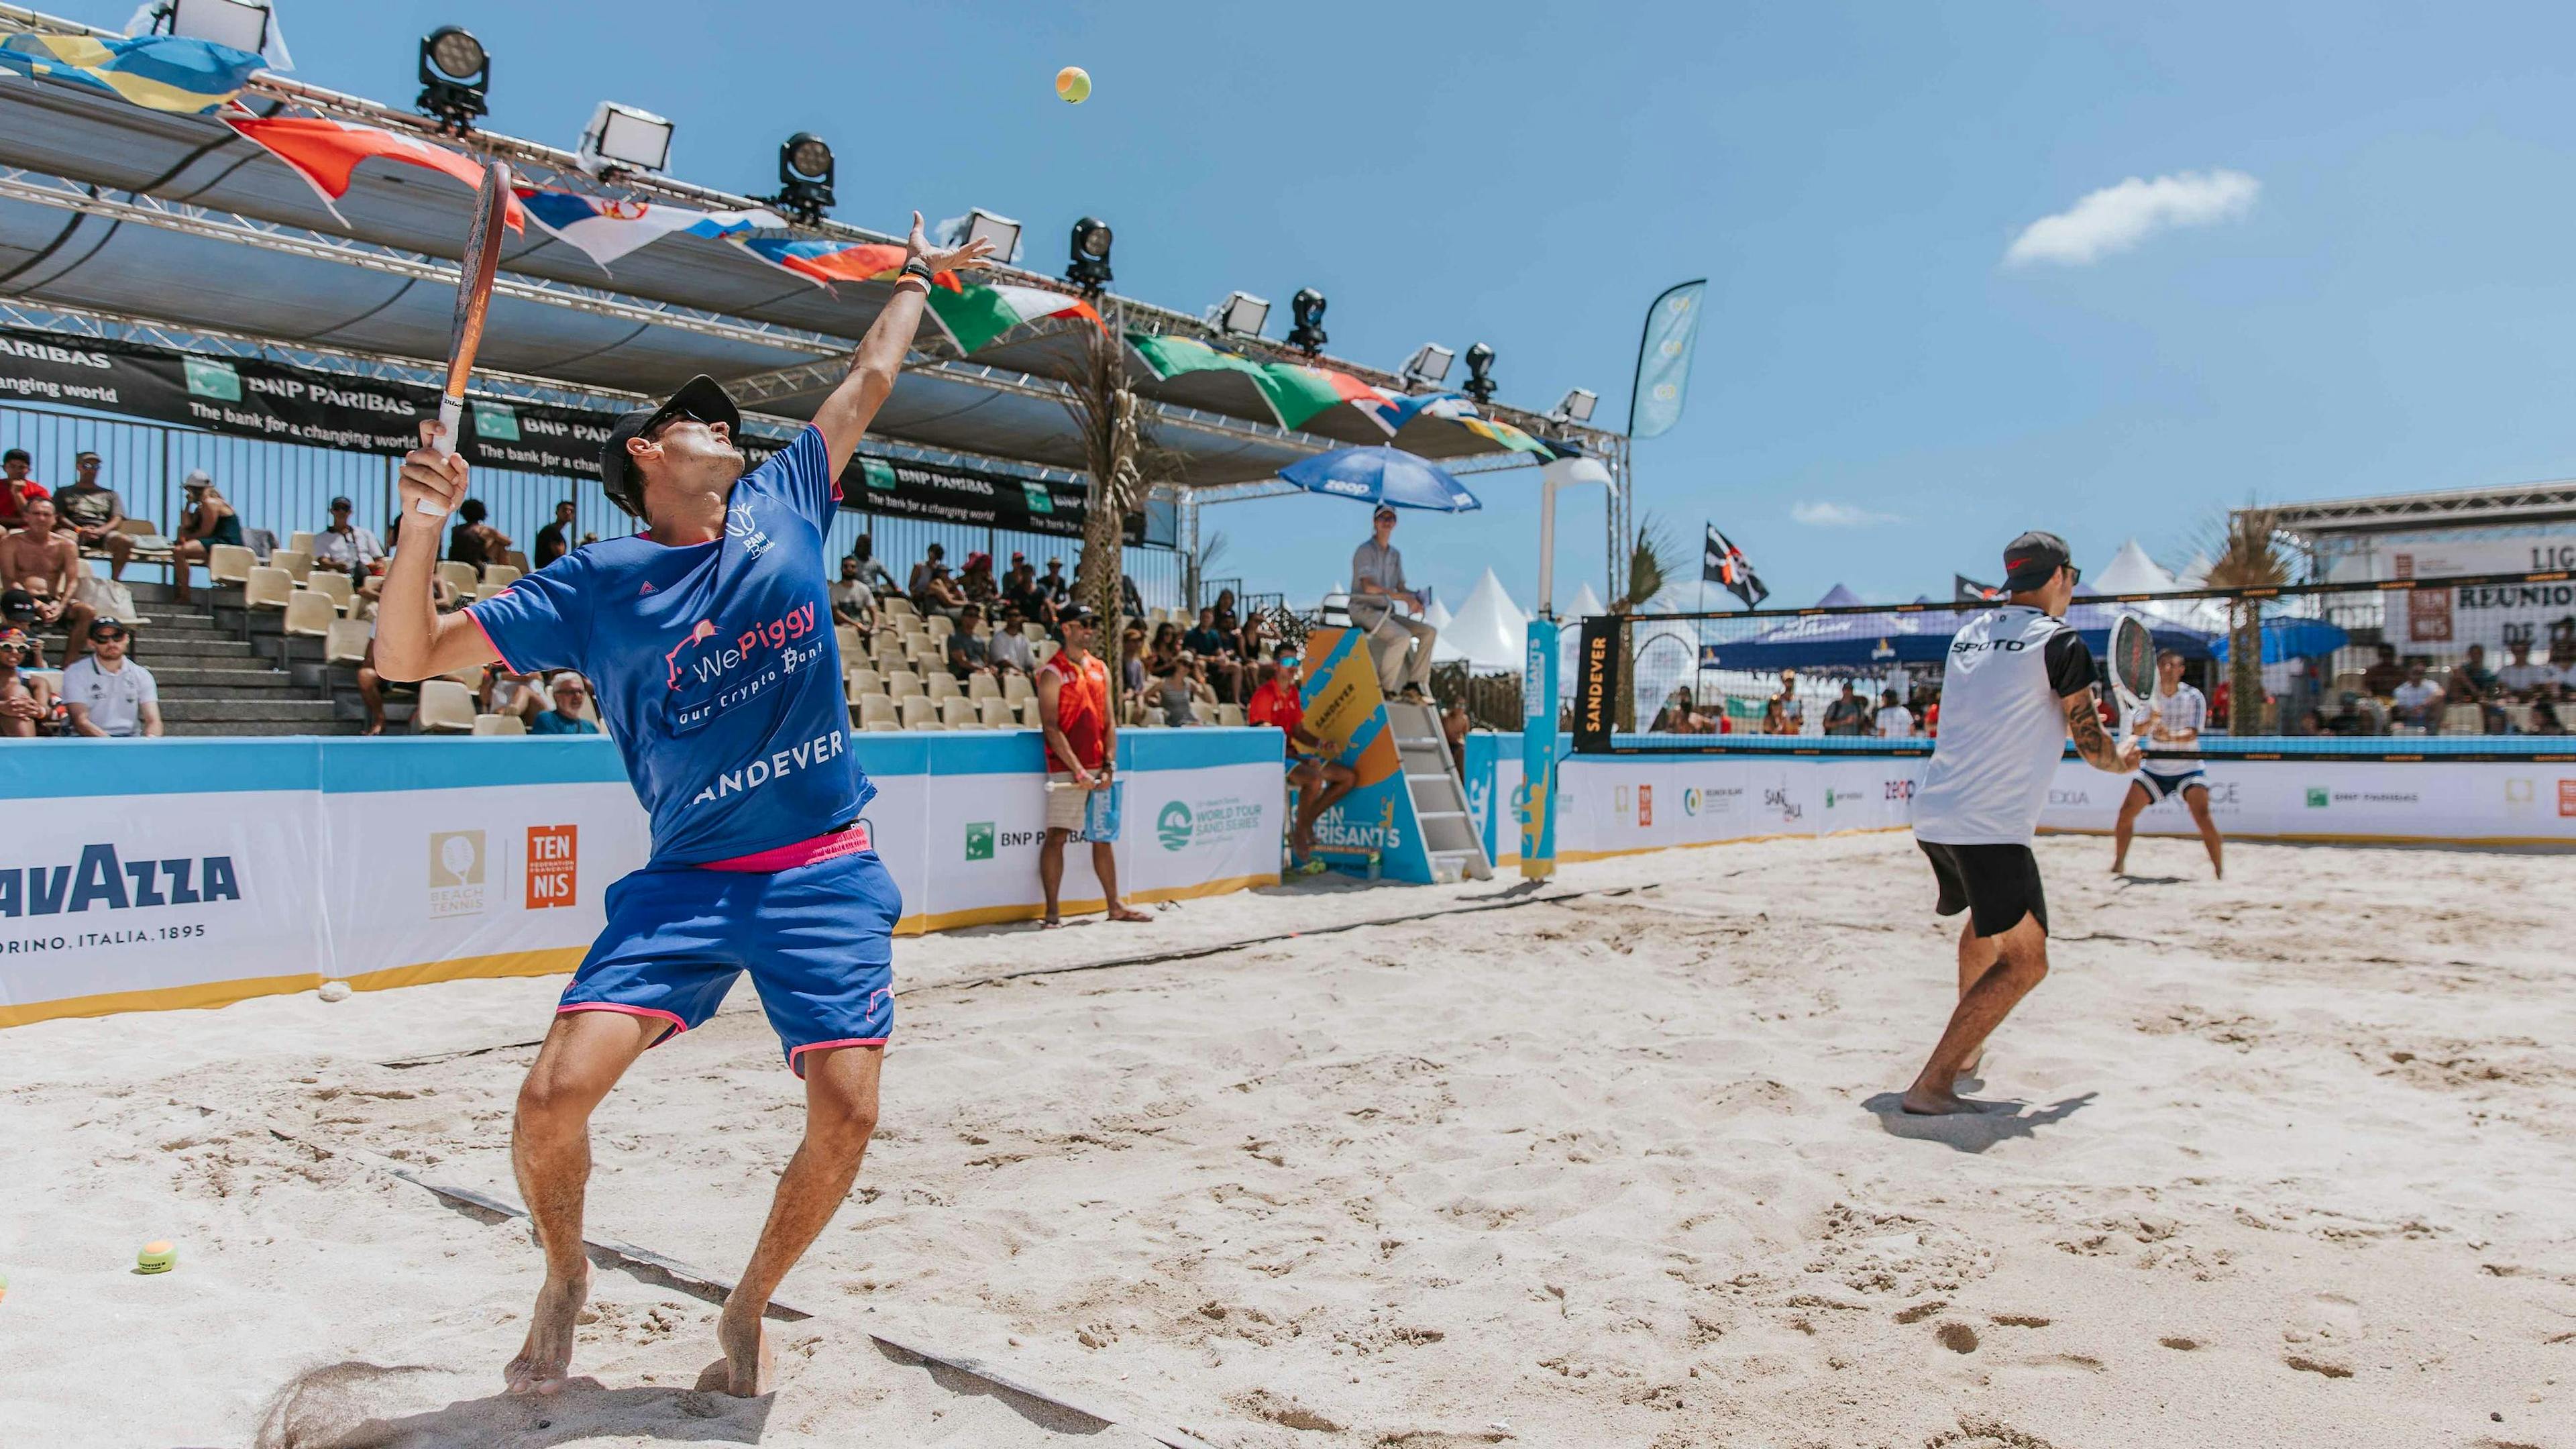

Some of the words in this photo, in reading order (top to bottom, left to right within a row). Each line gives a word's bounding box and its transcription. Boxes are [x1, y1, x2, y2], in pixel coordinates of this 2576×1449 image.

[62, 383, 119, 403] world
[248, 376, 305, 398] BNP
[309, 384, 417, 416] PARIBAS
[189, 401, 221, 421] The
[223, 407, 263, 429] bank
[263, 415, 289, 433] for
[289, 423, 302, 435] a
[302, 425, 372, 449] changing
[373, 433, 419, 449] world
[523, 417, 569, 437] BNP
[572, 424, 613, 443] PAR
[477, 443, 505, 460] The
[506, 447, 539, 464] bank
[540, 451, 562, 468] for
[561, 457, 572, 468] a
[572, 458, 602, 473] chan
[896, 468, 931, 486] BNP
[931, 472, 995, 496] PARIBAS
[867, 491, 885, 505] The
[884, 494, 906, 510] bank
[927, 503, 969, 521] changing
[969, 509, 996, 523] world
[743, 531, 767, 549] PAM
[747, 539, 775, 560] Beach
[2459, 586, 2576, 610] REUNIO
[1951, 639, 2025, 654] SPOTO
[1586, 637, 1607, 732] SANDEVER
[1316, 684, 1355, 729] SANDEVER
[683, 730, 844, 810] ANDEVER
[533, 835, 570, 861] TEN
[1002, 833, 1032, 847] BNP
[1312, 826, 1401, 849] RISANTS
[430, 888, 484, 903] BEACH
[534, 873, 570, 899] NIS
[430, 899, 484, 914] TENNIS
